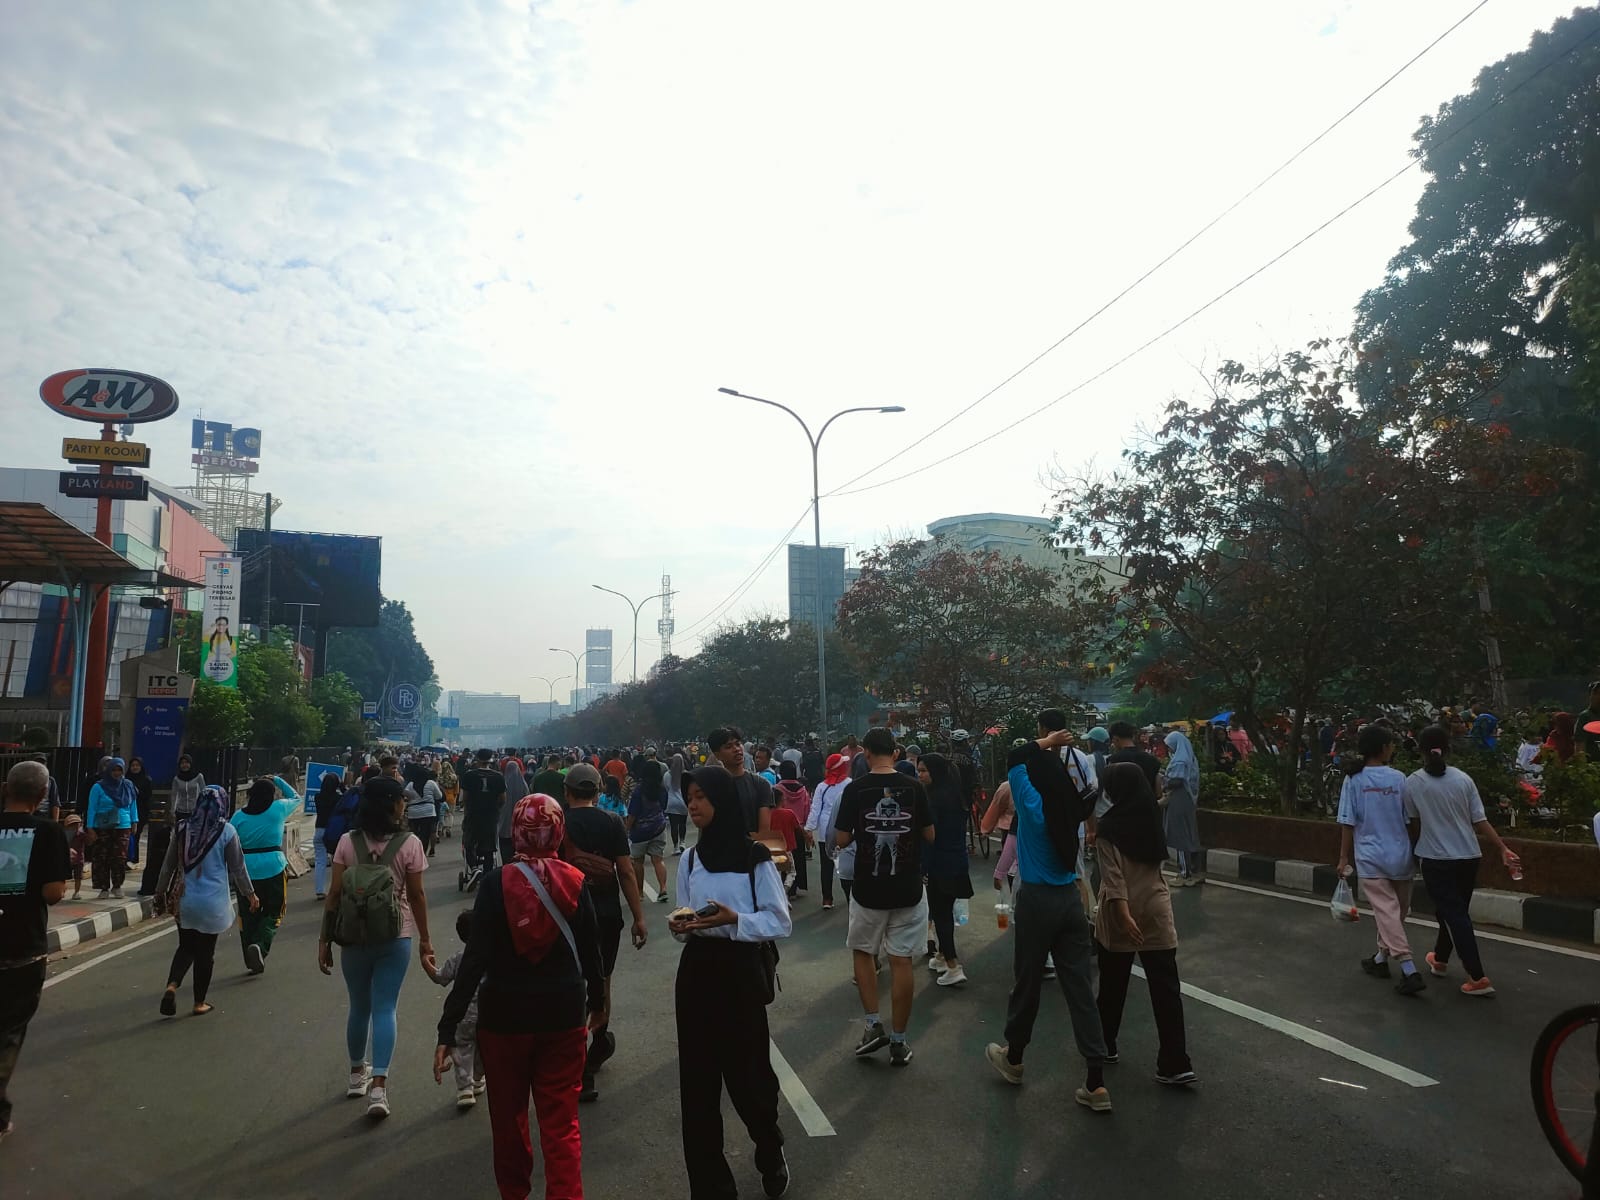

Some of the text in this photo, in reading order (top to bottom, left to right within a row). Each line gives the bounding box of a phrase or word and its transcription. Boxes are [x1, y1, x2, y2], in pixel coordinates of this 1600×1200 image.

[62, 379, 154, 410] A&W
[191, 419, 261, 458] ITC
[66, 443, 141, 457] PARTY ROOM
[202, 456, 247, 469] DEPOK
[68, 478, 135, 491] PLAYLAND
[148, 675, 178, 687] ITC
